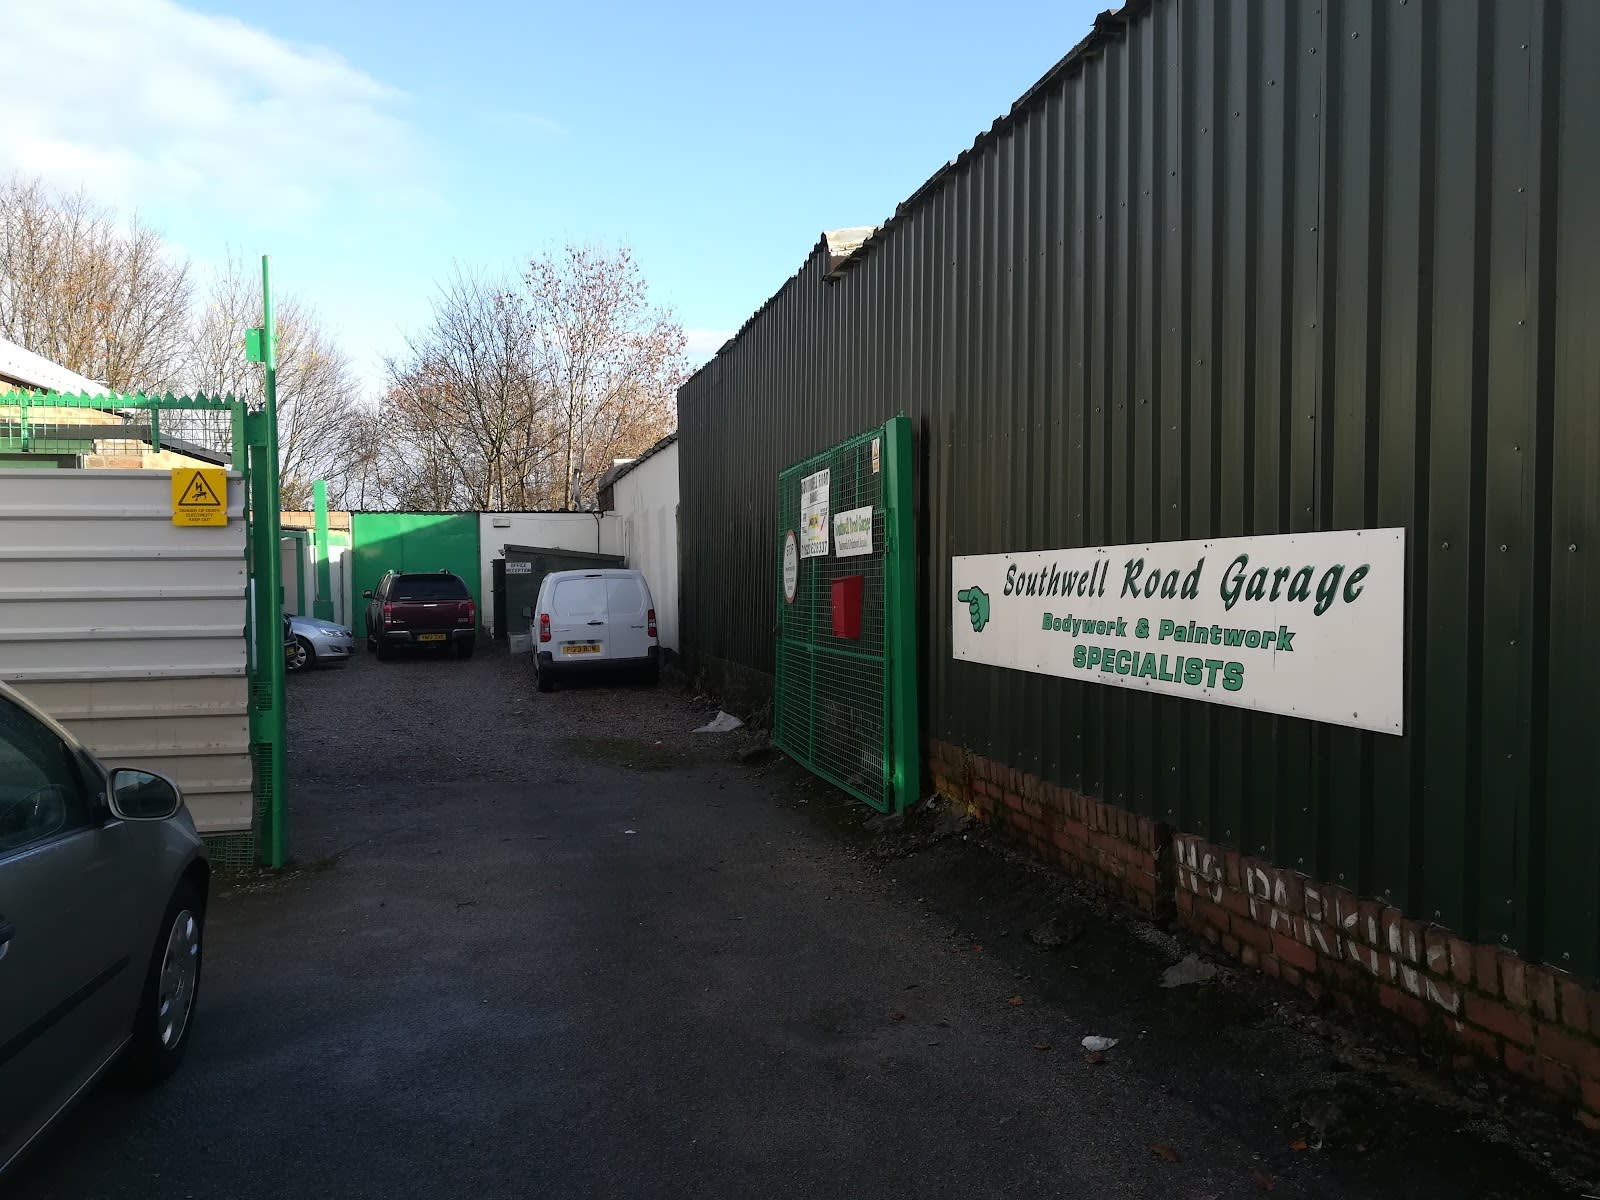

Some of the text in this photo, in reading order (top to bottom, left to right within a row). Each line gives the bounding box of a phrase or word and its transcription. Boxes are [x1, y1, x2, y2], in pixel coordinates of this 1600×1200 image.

[1003, 553, 1371, 616] Southwell Road Garage
[1041, 612, 1297, 652] Bodywork & Paintwork
[1072, 644, 1245, 692] SPECIALISTS
[1176, 839, 1466, 1033] NO PARKING
